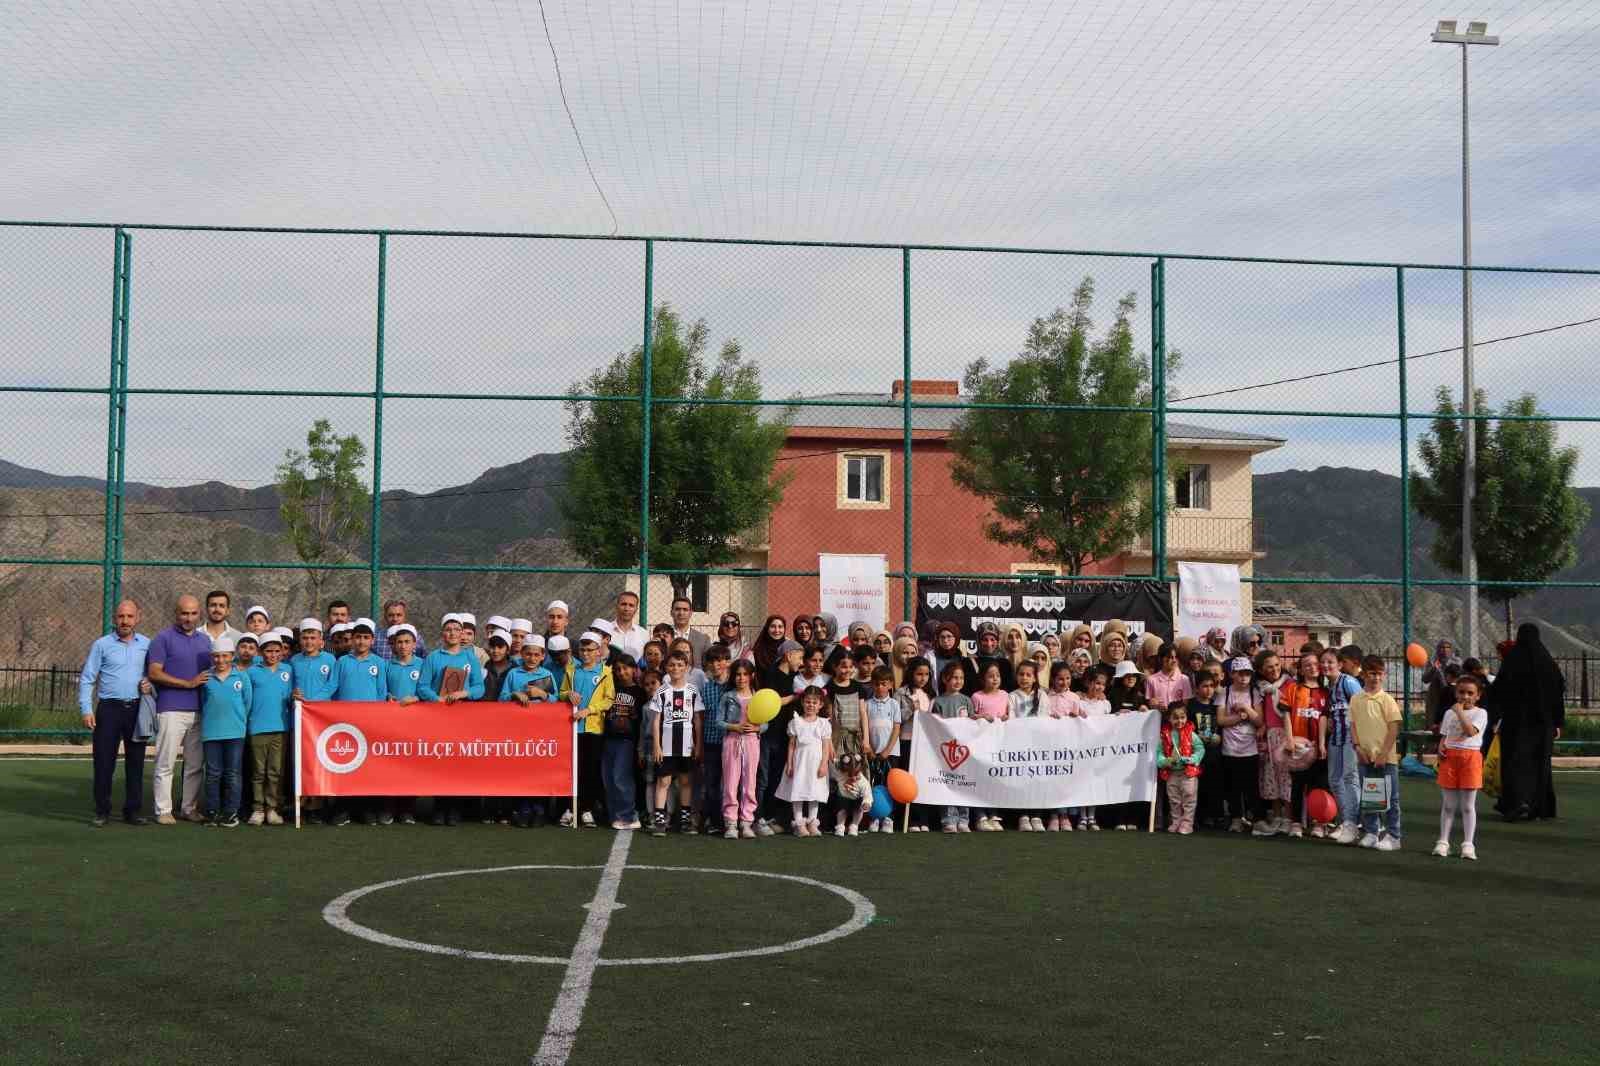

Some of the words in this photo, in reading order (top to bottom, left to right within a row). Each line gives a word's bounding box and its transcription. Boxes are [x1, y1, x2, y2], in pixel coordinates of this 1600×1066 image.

[371, 741, 413, 756] OLTU
[417, 738, 455, 759] İLÇE
[459, 738, 559, 758] MÜFTÜLÜĞÜ
[1054, 746, 1105, 761] DİYANET
[988, 766, 1024, 777] OLTU
[1027, 763, 1073, 779] ŞUBESİ
